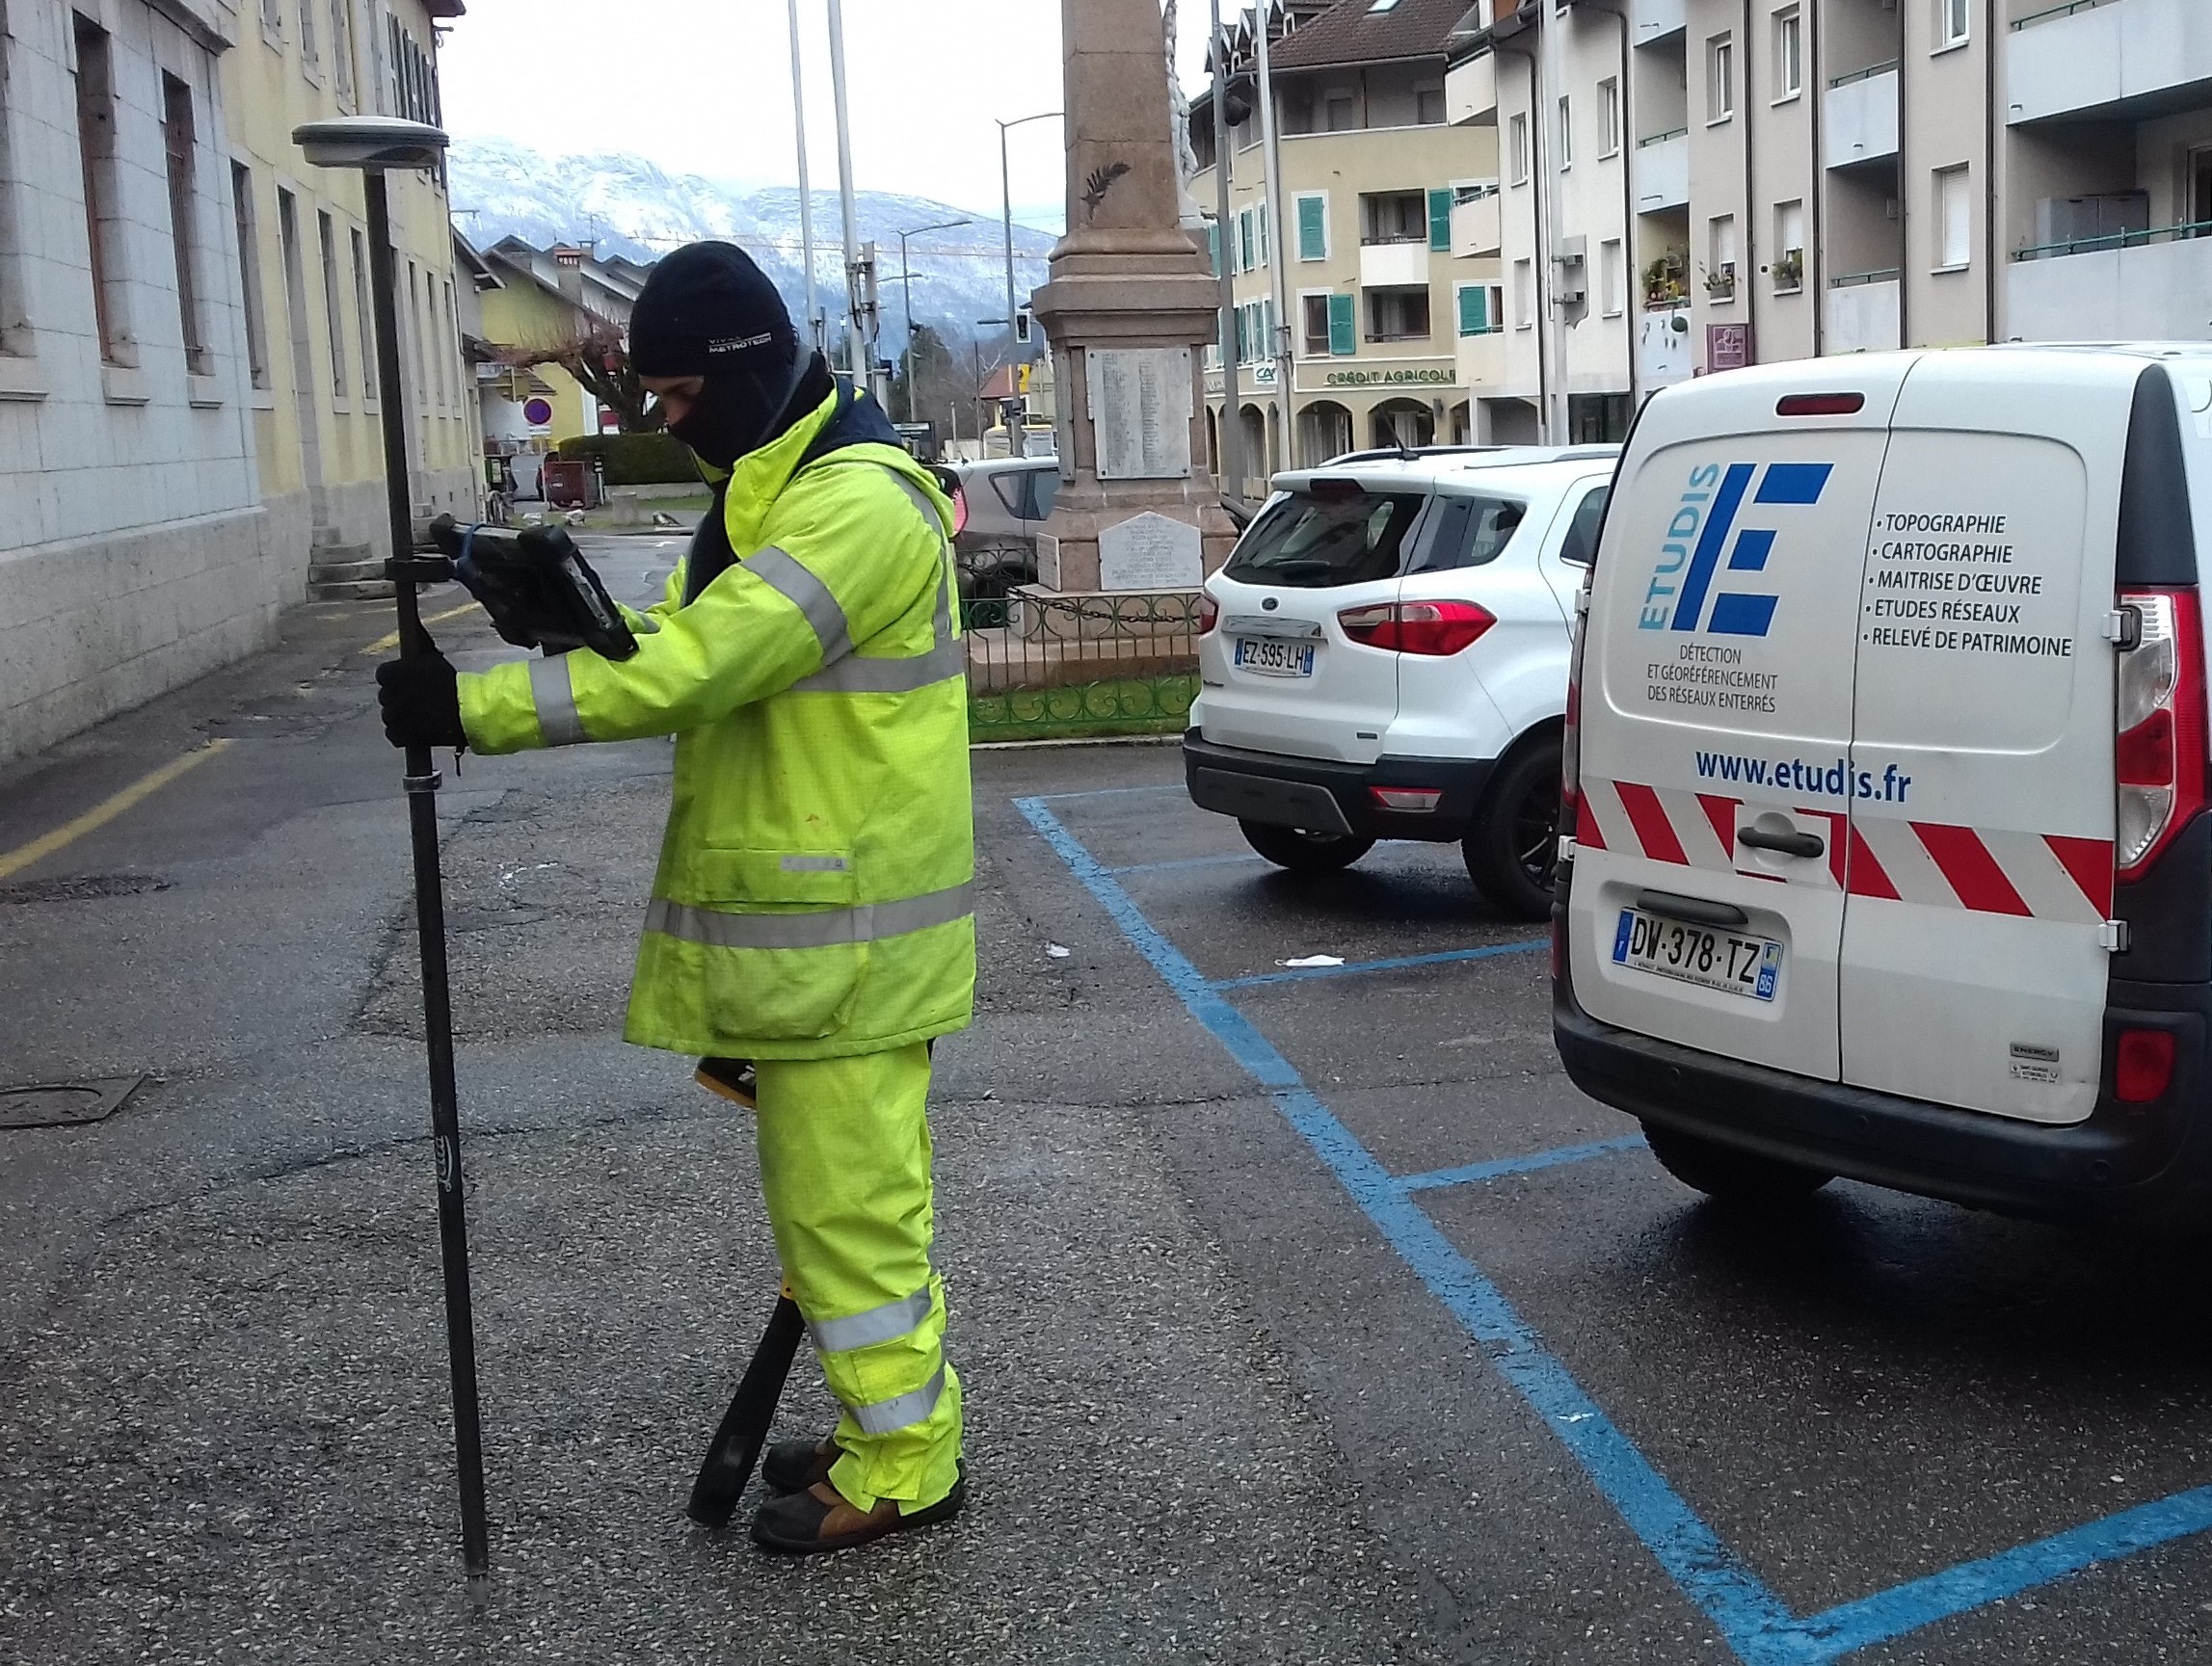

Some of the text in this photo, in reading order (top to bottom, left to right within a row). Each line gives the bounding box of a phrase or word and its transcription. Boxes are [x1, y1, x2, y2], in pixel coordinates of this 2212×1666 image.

[1885, 514, 2007, 534] TOPOGRAPHIE
[1639, 463, 1719, 630] ETUDIS
[1881, 542, 2013, 563] CARTOGRAPHIE
[1878, 570, 1955, 590] MAITRISE
[1875, 599, 2021, 623] ETUDES RÉSEAUX
[1872, 626, 2073, 656] RELEVÉ DE PATRIMOINE
[1680, 643, 1742, 665] DÉTECTION
[1647, 664, 1778, 690] ET GÉORÉFÉRENCEMENT
[1647, 685, 1775, 713] DES RÉSEAUX ENTERRÉS
[1695, 752, 1911, 803] www.etudis.fr
